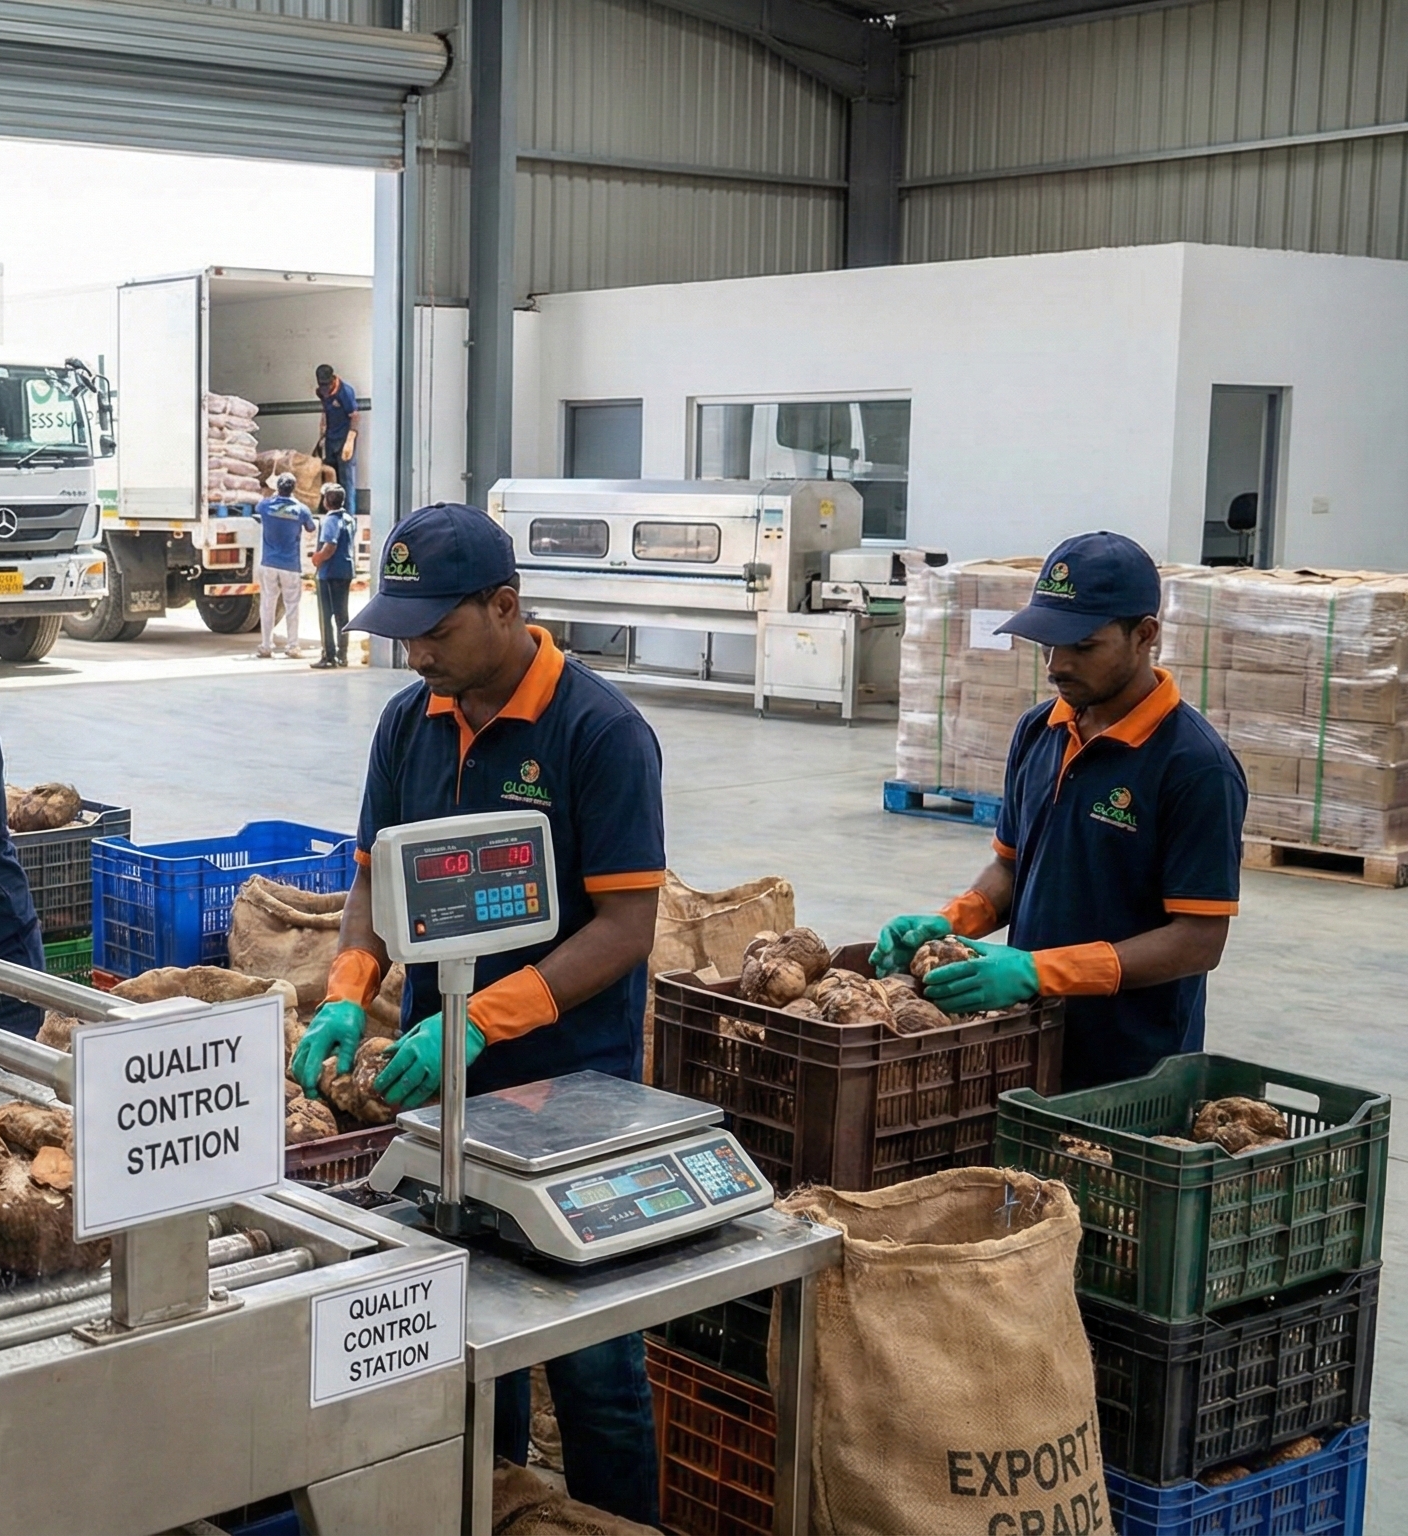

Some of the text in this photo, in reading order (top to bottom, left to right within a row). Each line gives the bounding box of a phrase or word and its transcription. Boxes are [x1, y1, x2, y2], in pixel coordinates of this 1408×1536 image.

[503, 780, 552, 800] GLOBAL
[124, 1035, 243, 1084] QUALITY
[117, 1081, 250, 1131] CONTROL
[127, 1126, 240, 1175] STATION
[349, 1279, 433, 1320] QUALITY
[343, 1310, 437, 1353] CONTROL
[349, 1340, 429, 1382] STATION
[947, 1421, 1089, 1498] EXPORT
